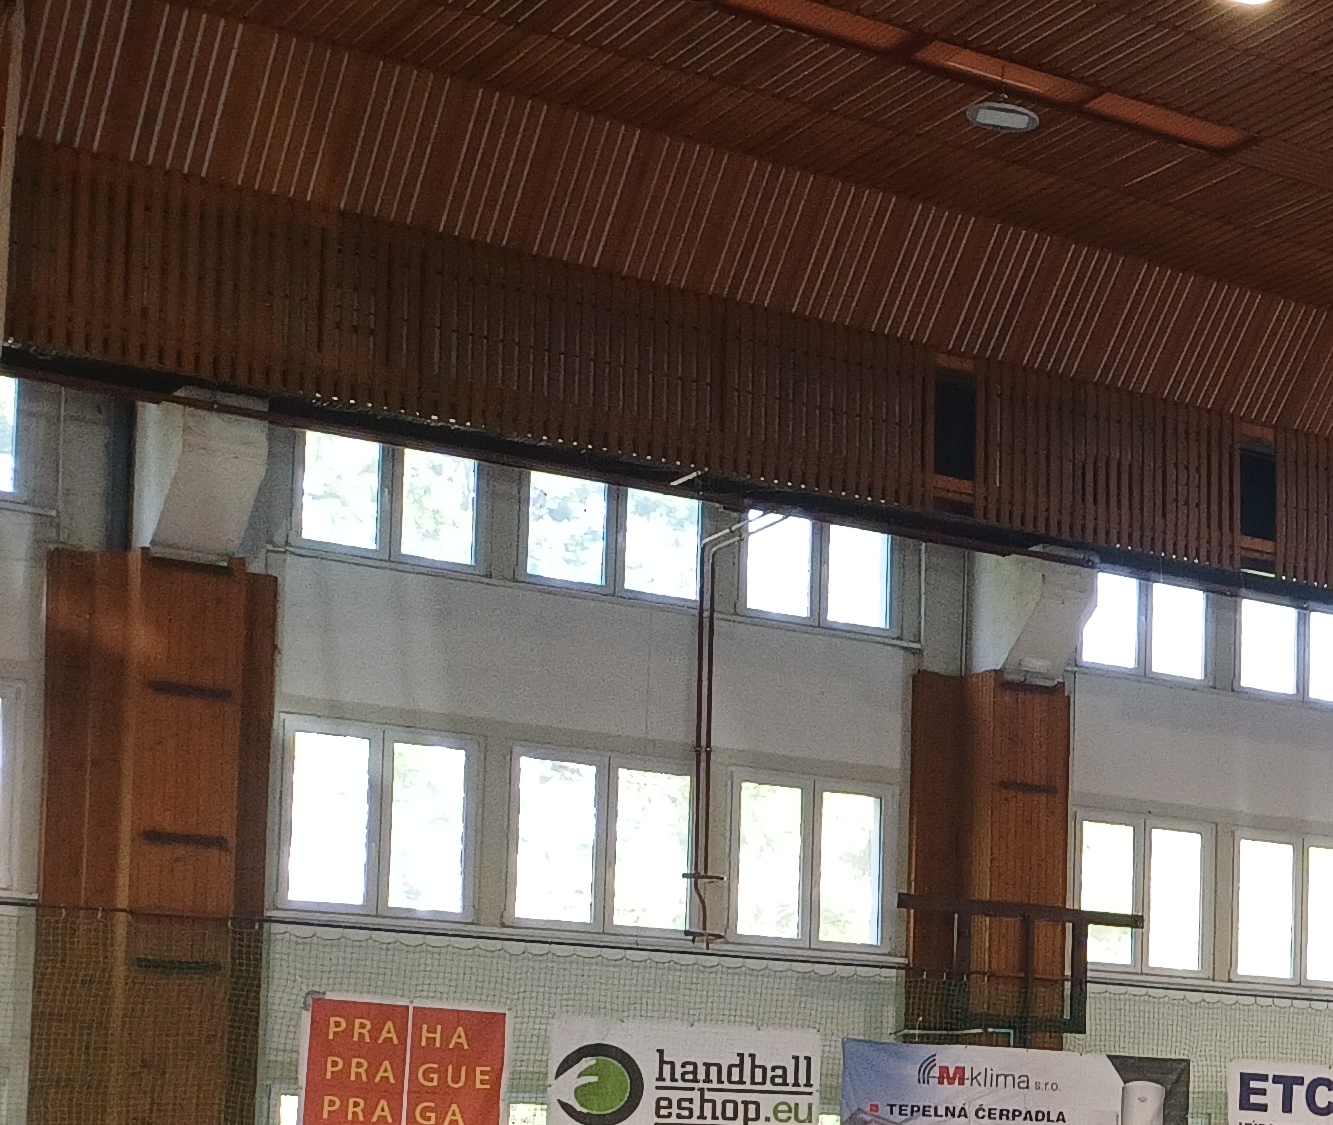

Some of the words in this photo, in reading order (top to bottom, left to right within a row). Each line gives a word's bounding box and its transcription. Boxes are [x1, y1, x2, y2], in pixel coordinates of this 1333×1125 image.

[655, 1048, 814, 1088] handball
[1034, 1081, 1062, 1092] s.r.o.
[886, 1102, 969, 1119] TEPELNÁ
[974, 1103, 1067, 1124] ČERPADLA
